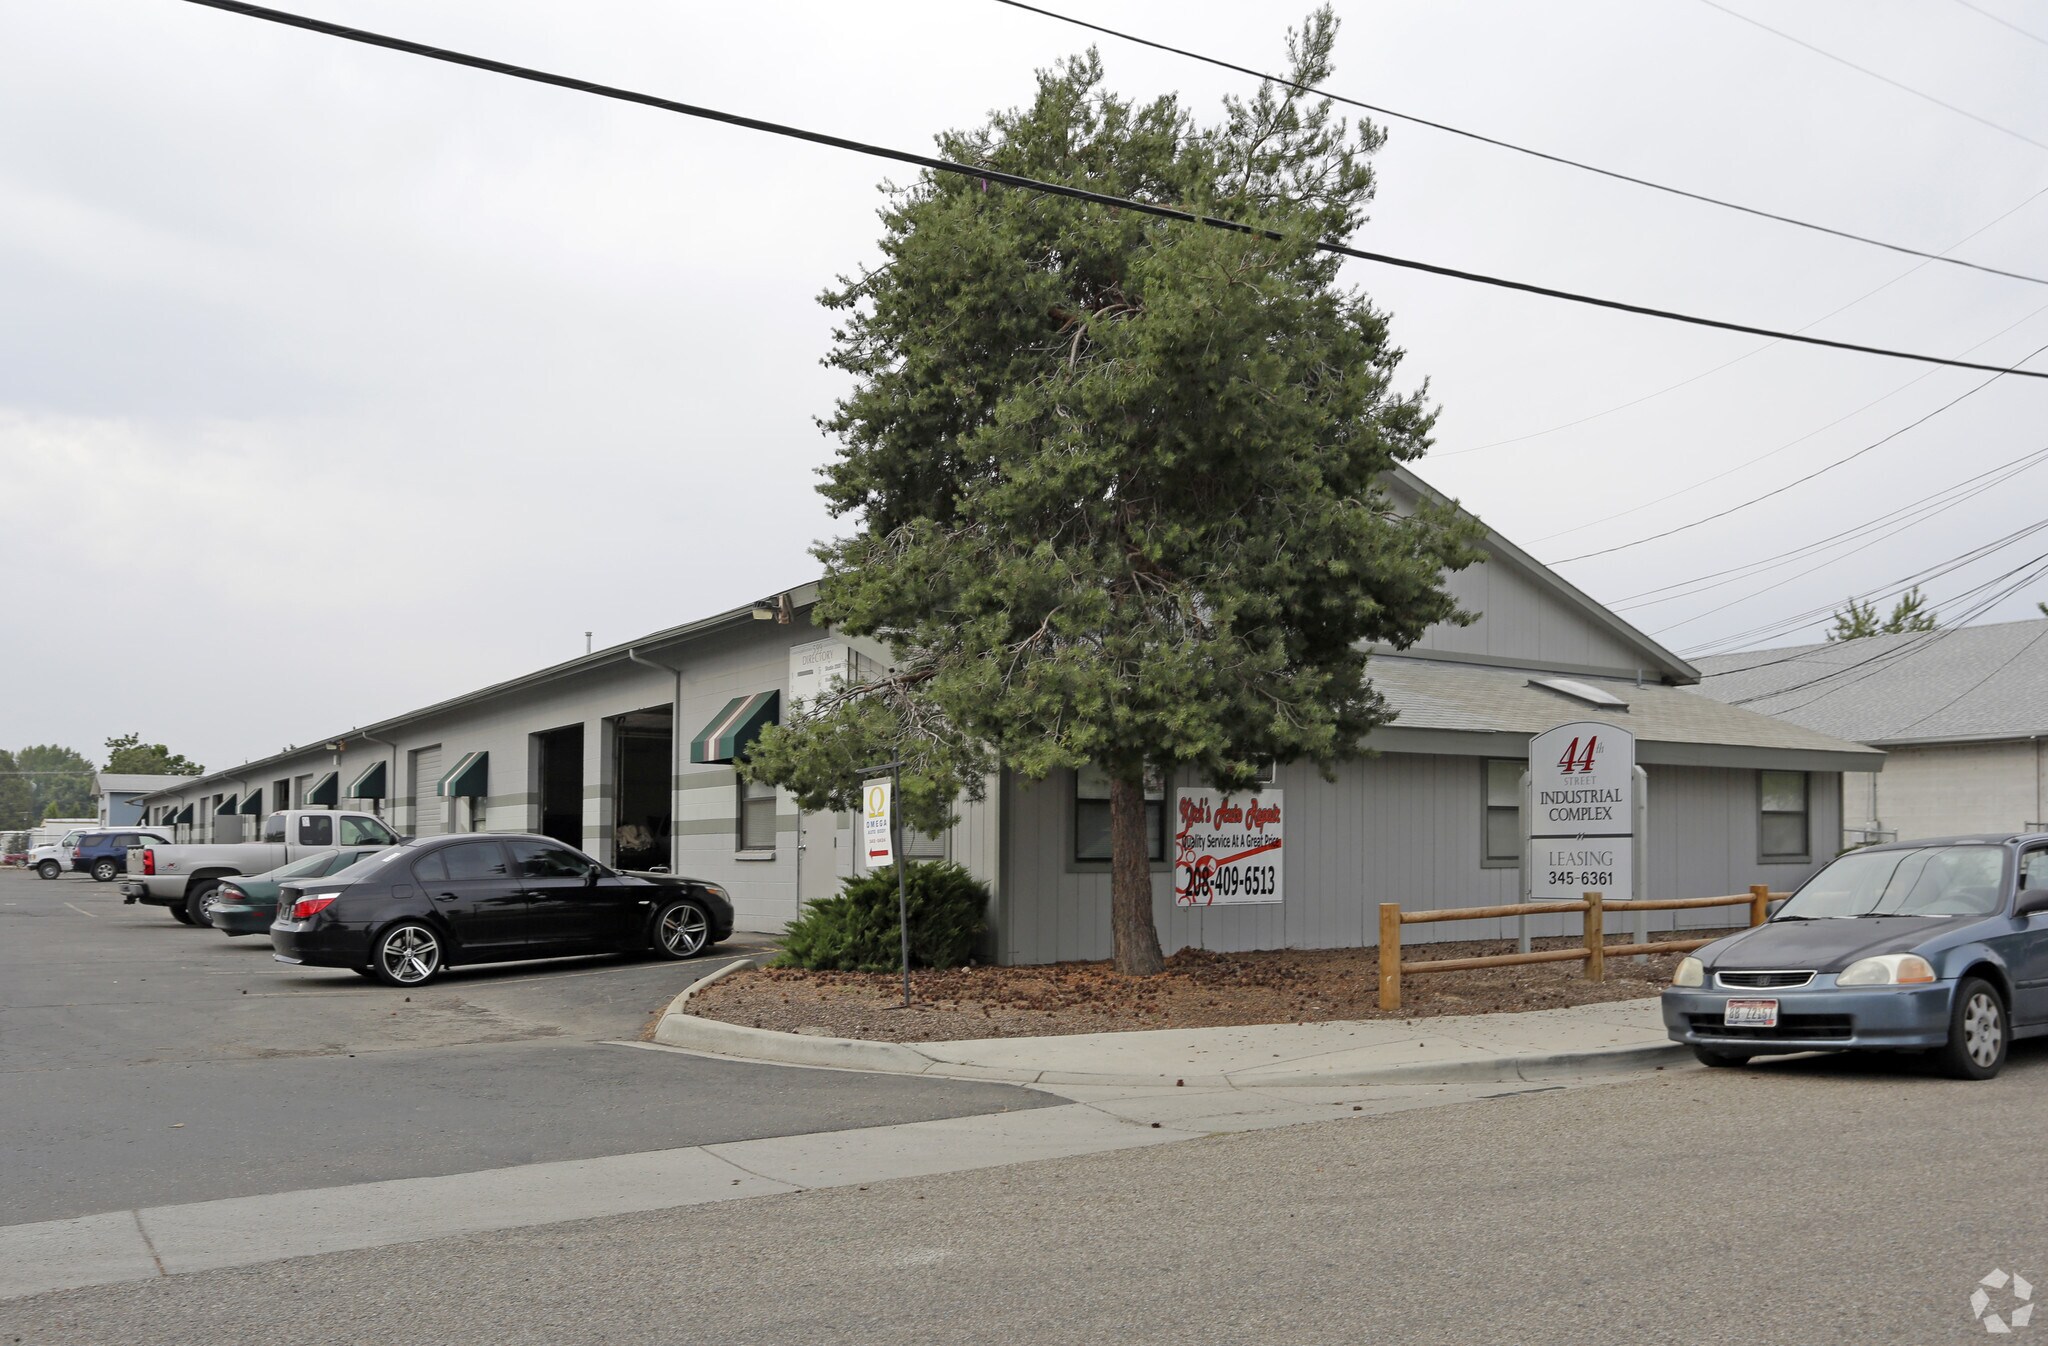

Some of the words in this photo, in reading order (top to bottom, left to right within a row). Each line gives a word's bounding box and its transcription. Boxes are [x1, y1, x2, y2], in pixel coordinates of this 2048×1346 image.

[802, 650, 833, 665] DIRECTORY
[1564, 776, 1597, 786] STREET
[1540, 788, 1623, 805] INDUSTRIAL
[1179, 796, 1211, 828] Kirk's
[1214, 798, 1243, 831] Auto
[1245, 798, 1281, 834] Repair
[1549, 806, 1613, 822] COMPLEX
[866, 819, 887, 828] OMEGA
[1182, 834, 1206, 851] Quality
[1206, 834, 1230, 848] Service
[1231, 834, 1240, 848] At
[1240, 835, 1246, 847] A
[1246, 834, 1263, 848] Great
[1549, 850, 1613, 867] LEASING
[1186, 865, 1275, 897] 208-409-6513
[1549, 871, 1613, 886] 345-6361
